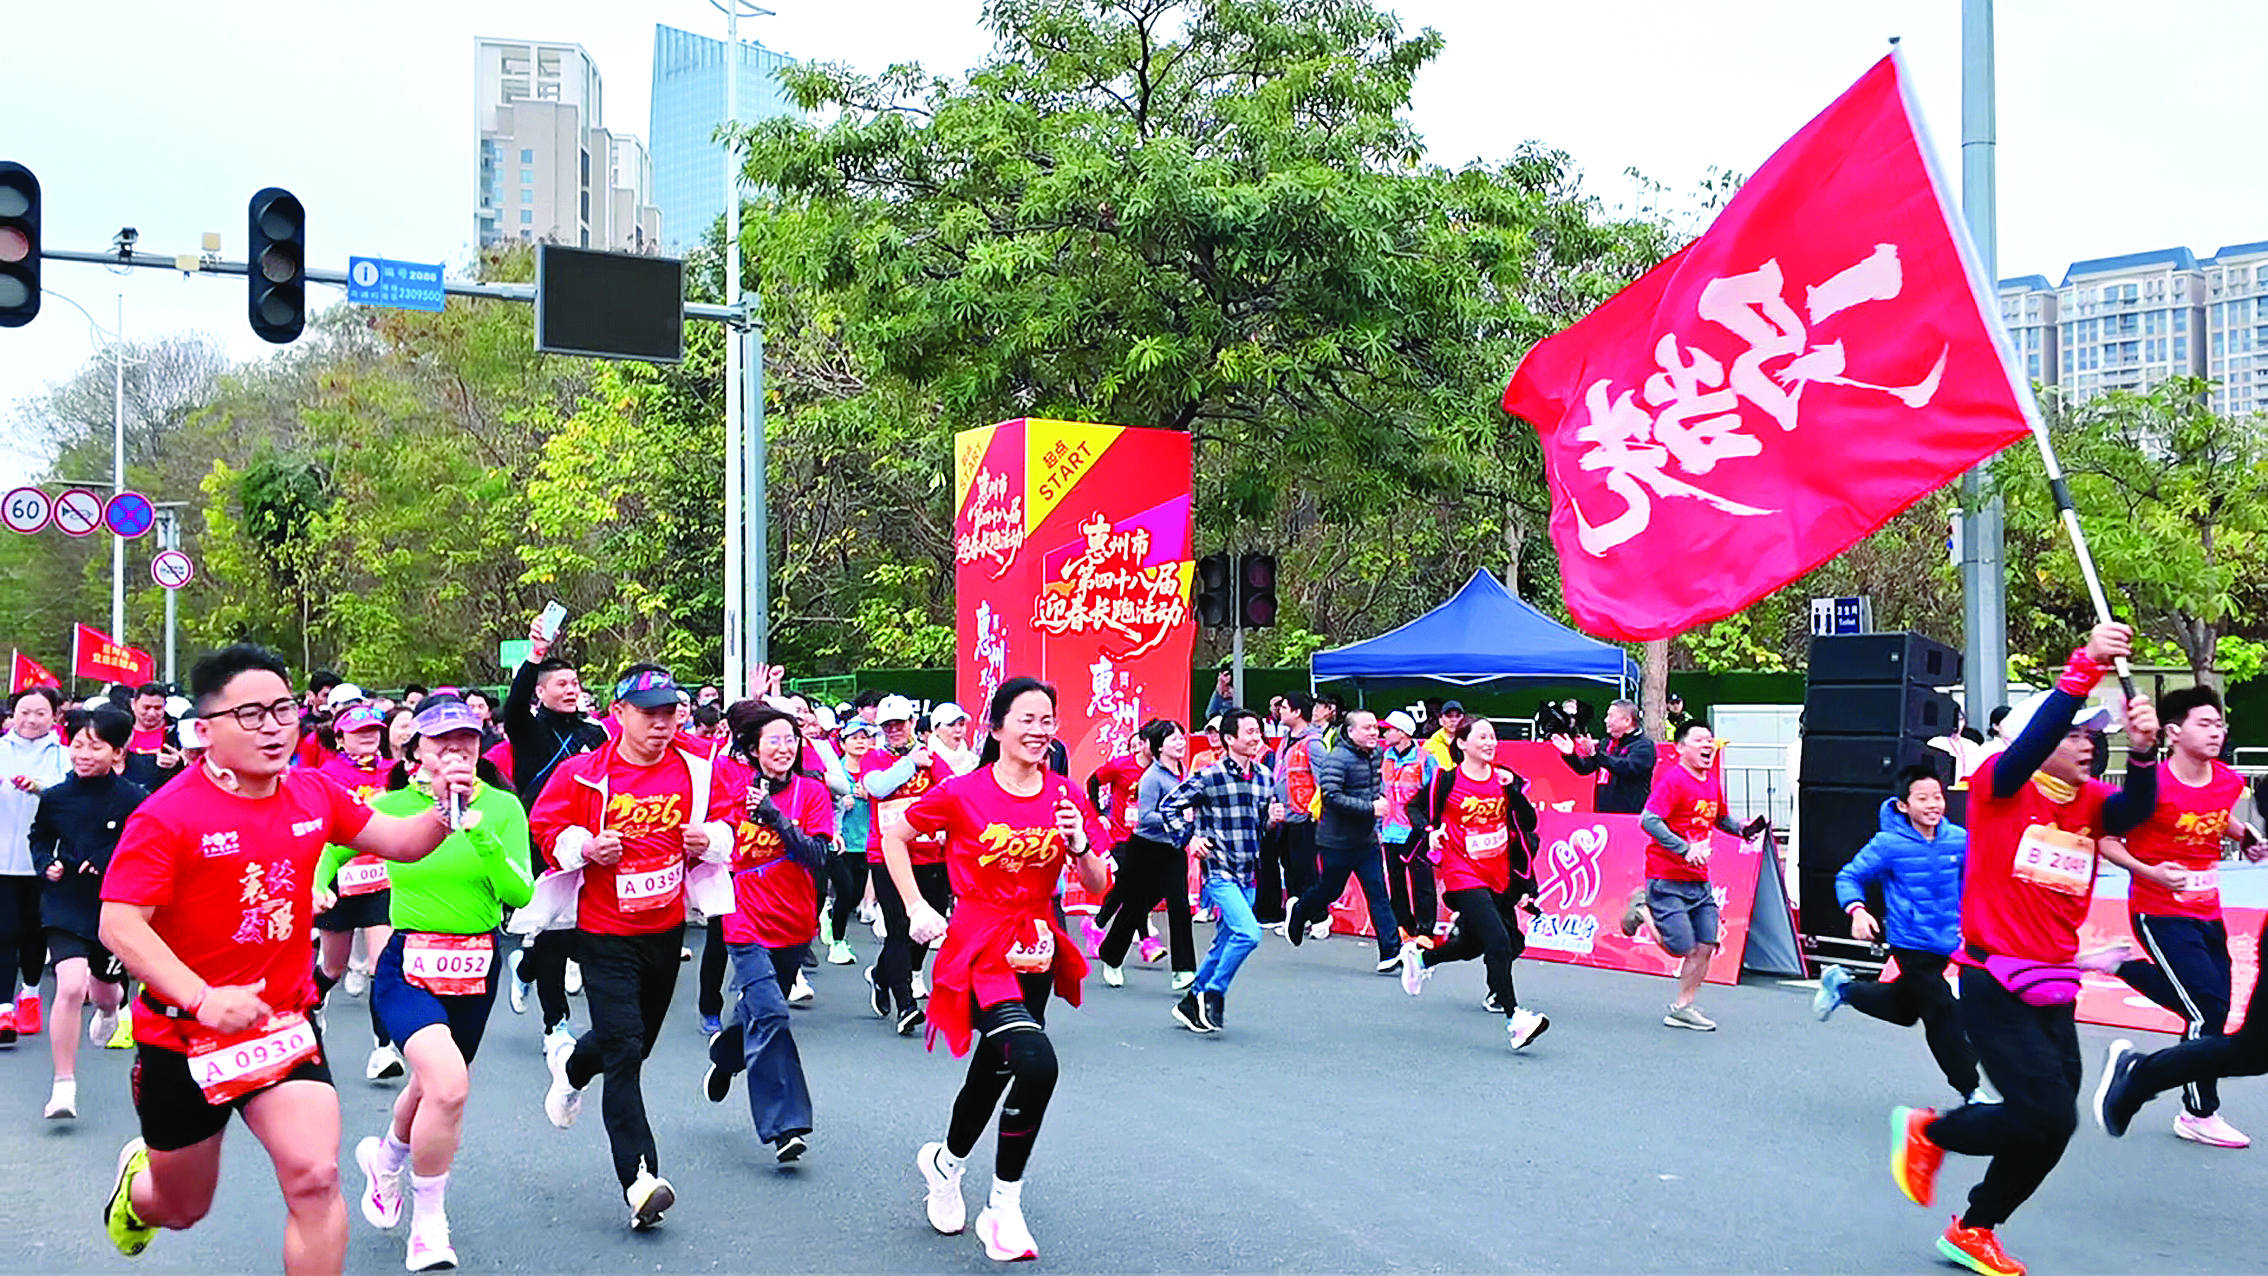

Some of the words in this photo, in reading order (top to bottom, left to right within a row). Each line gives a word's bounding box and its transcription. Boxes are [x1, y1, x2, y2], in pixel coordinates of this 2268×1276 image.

[959, 441, 983, 492] START
[1043, 440, 1069, 469] 起点
[1039, 440, 1092, 501] START
[12, 499, 40, 519] 60
[1083, 514, 1150, 566] 惠州市
[1061, 558, 1178, 602] 第四十八届
[1034, 593, 1186, 656] 迎春长跑活动
[1472, 840, 1479, 849] A
[2028, 847, 2041, 864] B
[344, 870, 354, 882] A
[625, 881, 636, 895] A
[412, 956, 425, 973] A
[436, 956, 485, 973] 0052
[206, 1061, 224, 1082] A
[235, 1034, 304, 1069] 0930
